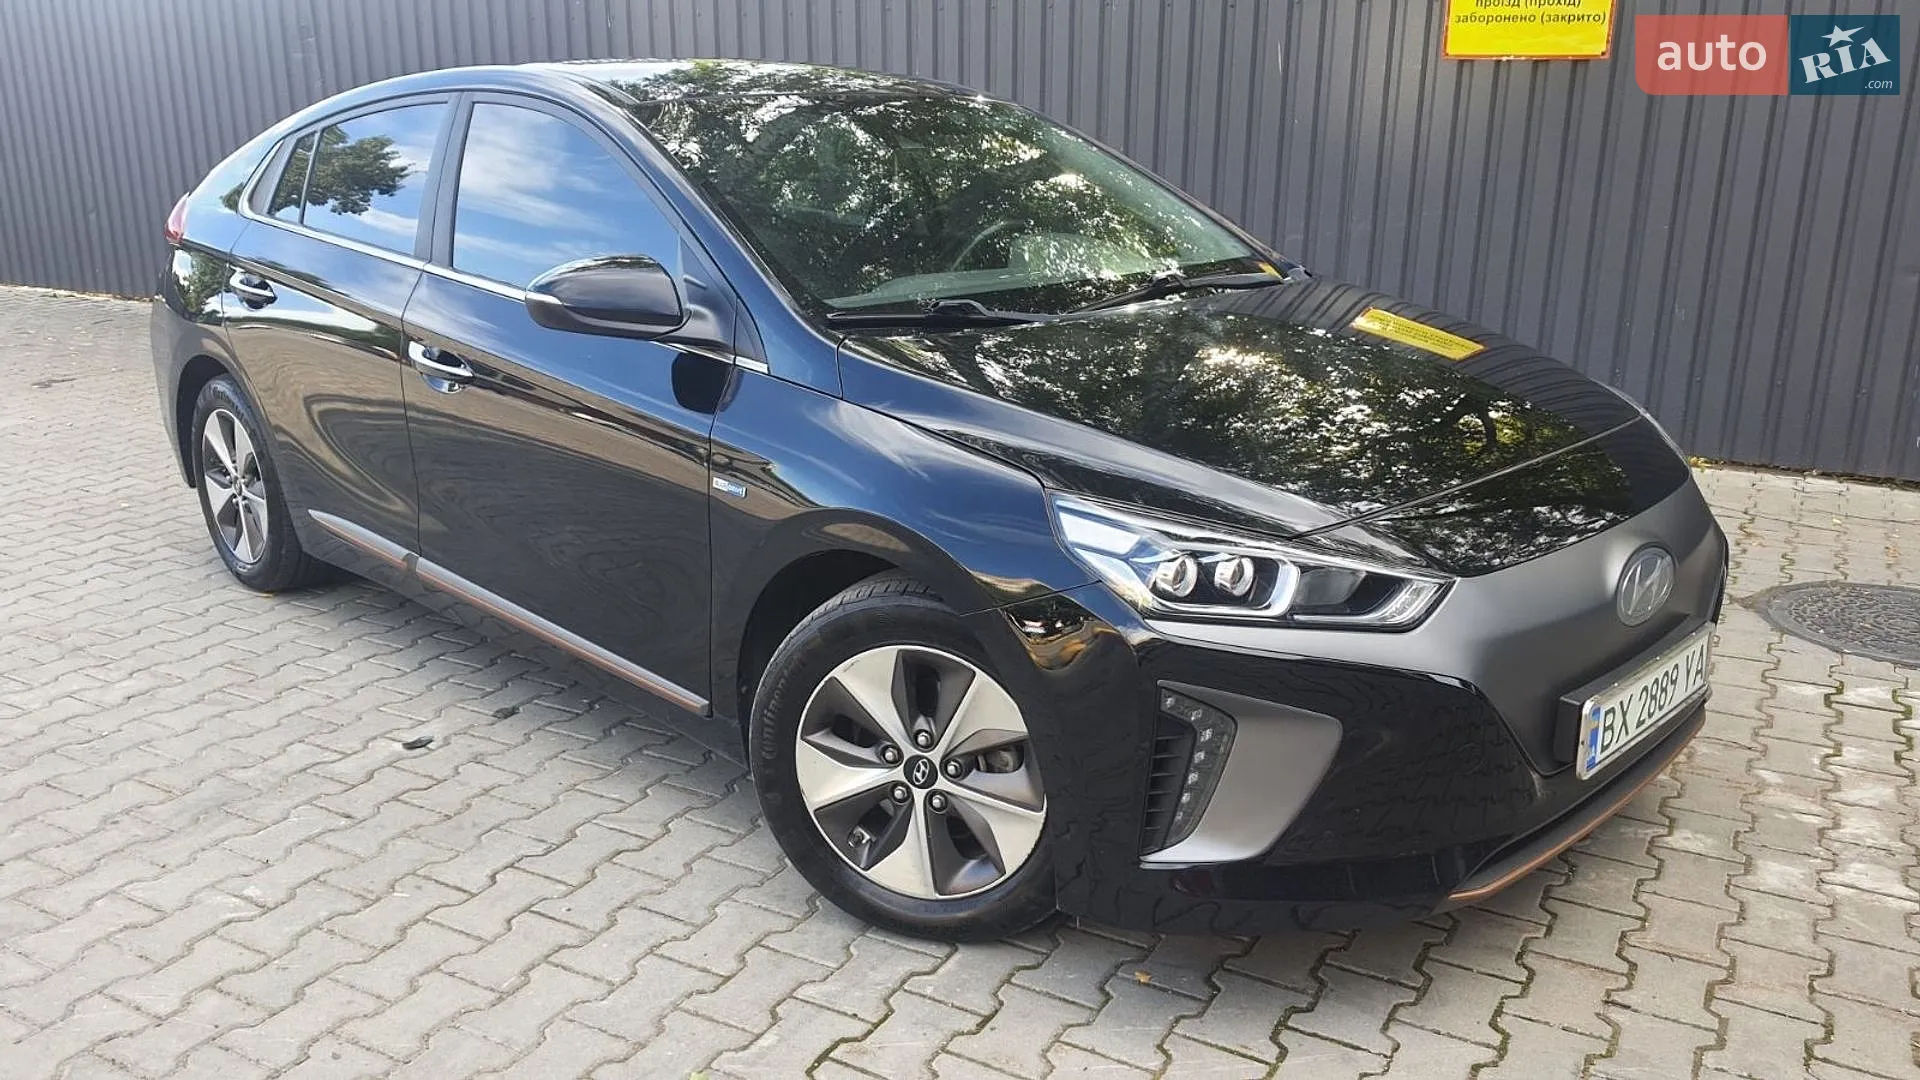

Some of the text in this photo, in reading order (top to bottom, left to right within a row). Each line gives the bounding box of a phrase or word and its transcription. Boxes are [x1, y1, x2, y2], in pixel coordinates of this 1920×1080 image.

[1455, 11, 1606, 25] заборонено (закрито)
[1600, 644, 1704, 754] BX 2889 YA
